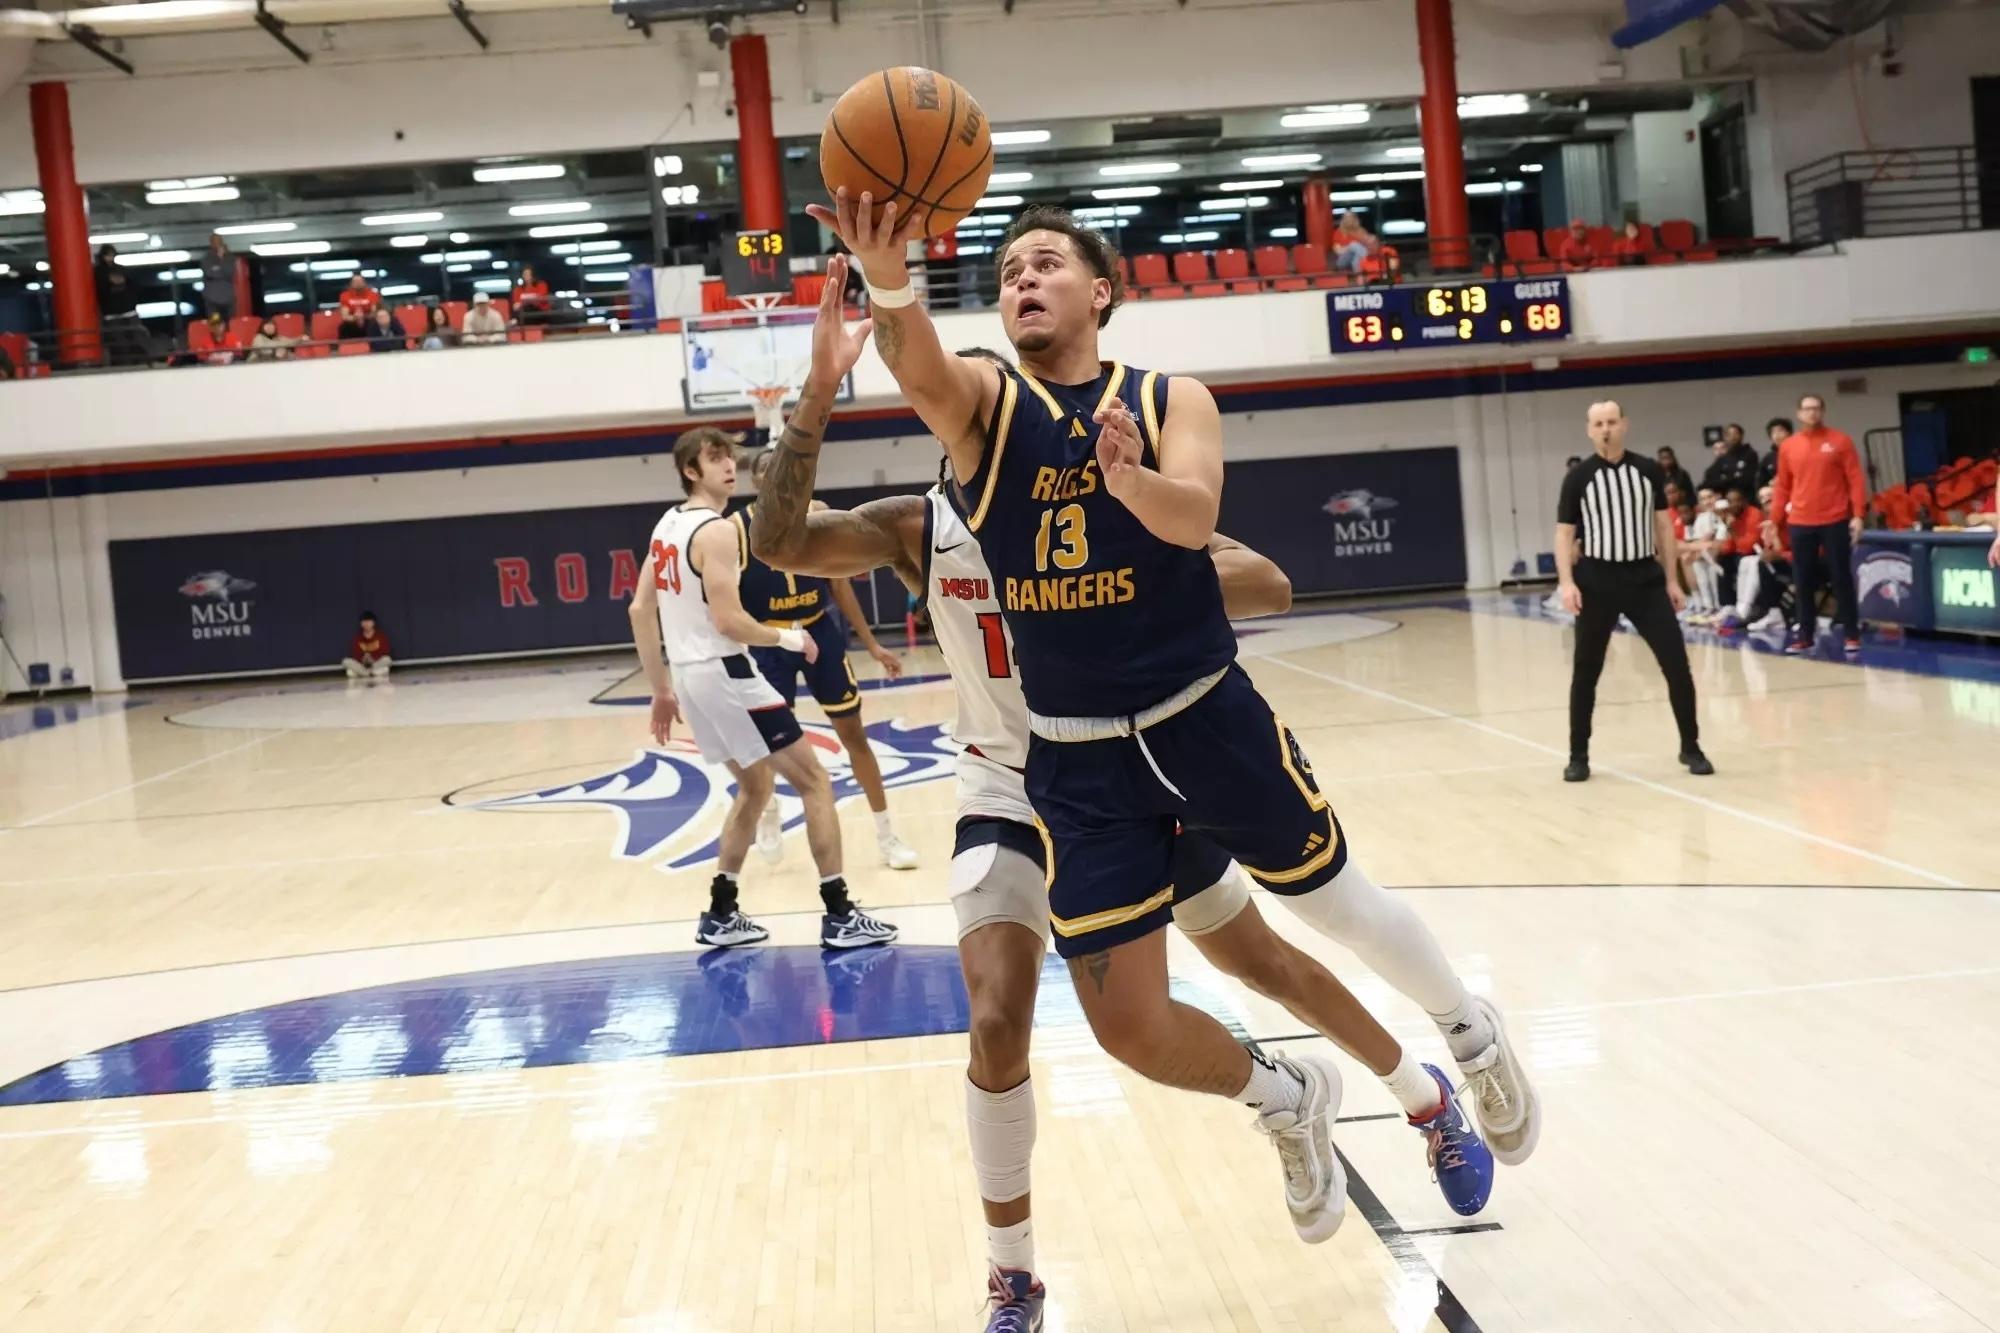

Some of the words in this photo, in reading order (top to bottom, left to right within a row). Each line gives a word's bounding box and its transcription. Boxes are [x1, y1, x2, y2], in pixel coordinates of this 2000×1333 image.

[738, 234, 783, 257] 6:13
[1334, 293, 1383, 311] METRO
[1427, 286, 1487, 316] 6:13
[1514, 281, 1560, 300] GUEST
[1347, 316, 1382, 343] 63
[1458, 318, 1473, 339] 2
[1527, 304, 1562, 331] 68
[1035, 503, 1089, 572] 13
[1334, 519, 1391, 543] MSU
[1335, 541, 1392, 557] DENVER
[494, 549, 641, 608] ROA
[652, 539, 681, 595] 20
[938, 577, 989, 601] MSU
[1006, 567, 1136, 612] RANGERS
[1942, 568, 1996, 608] NCAA
[191, 601, 249, 625] MSU
[192, 624, 251, 640] DENVER
[975, 611, 1019, 679] 1
